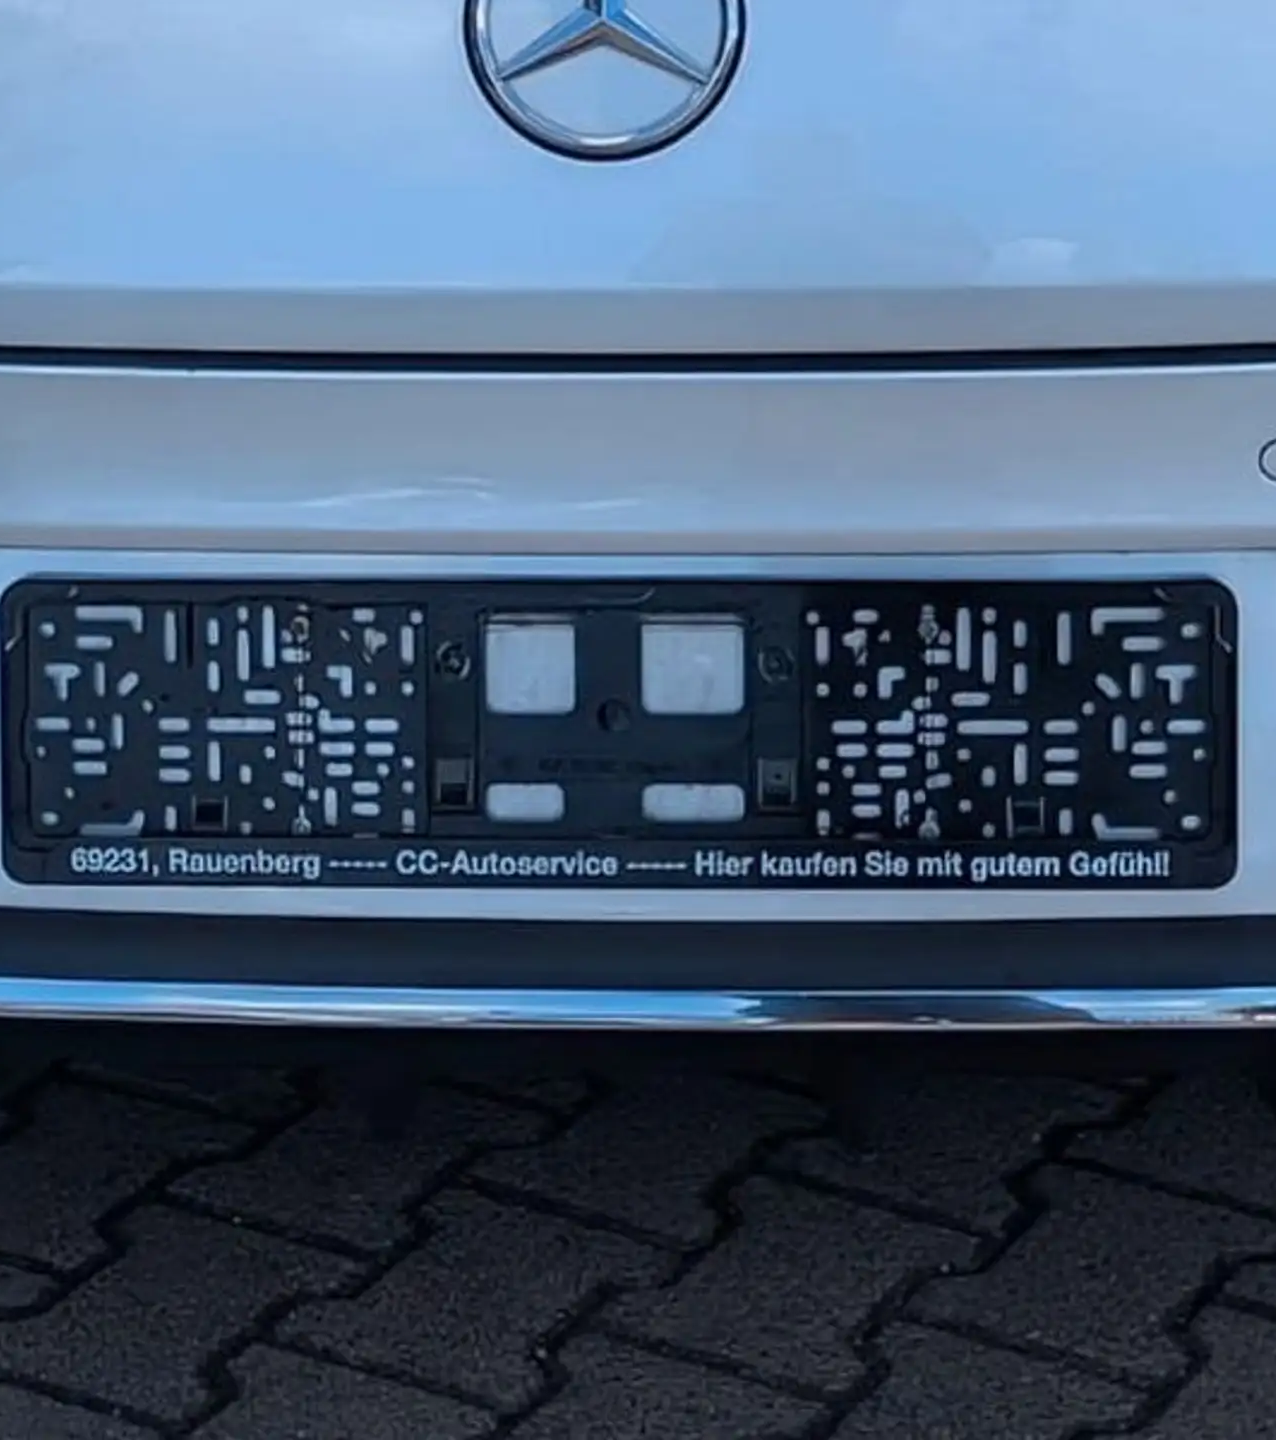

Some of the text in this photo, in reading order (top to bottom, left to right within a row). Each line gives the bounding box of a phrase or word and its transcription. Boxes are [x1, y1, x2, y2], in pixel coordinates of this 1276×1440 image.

[69, 846, 159, 877] 69231,
[167, 847, 322, 881] Rauenberg
[395, 848, 619, 876] CC-Autoservice
[694, 849, 755, 876] Hier
[760, 850, 858, 877] kaufen
[863, 850, 910, 877] Sie
[916, 850, 964, 877] mit
[969, 851, 1061, 882] gutem
[1068, 849, 1170, 877] Gefühl!
